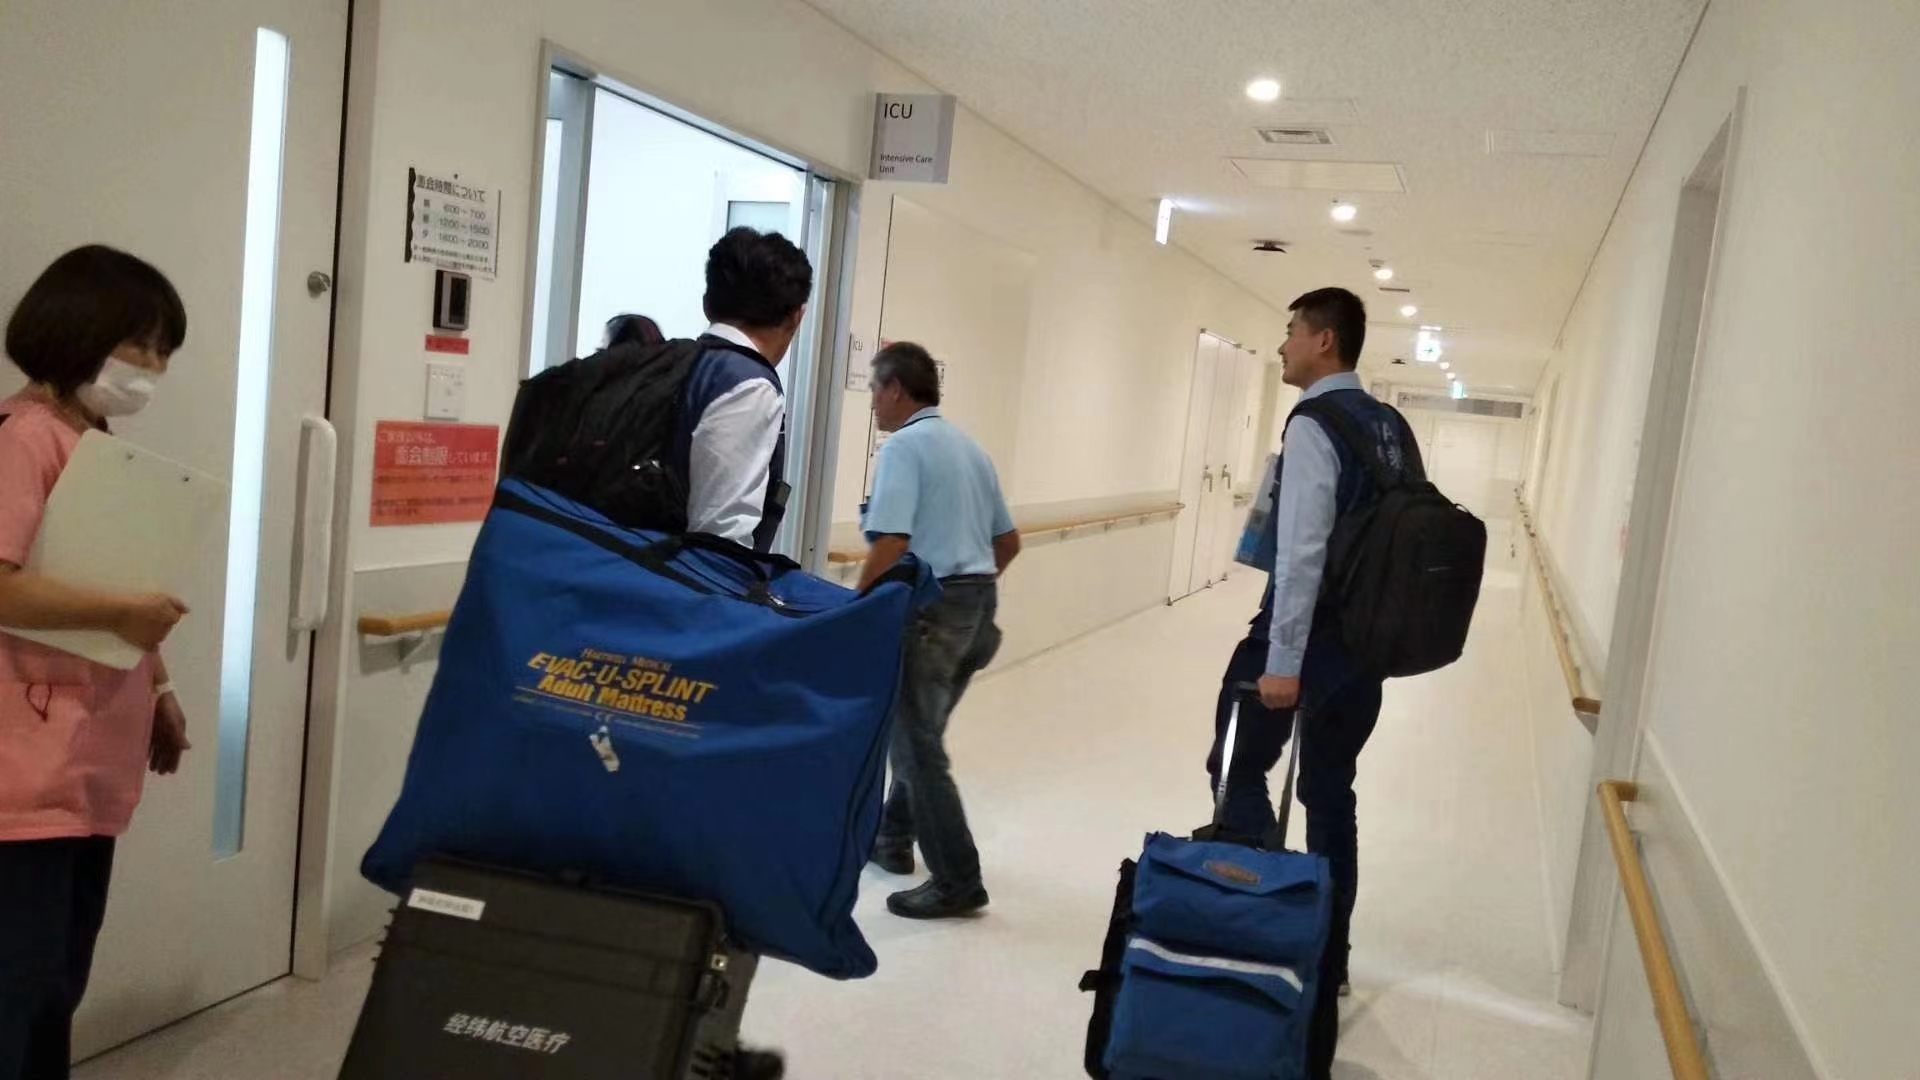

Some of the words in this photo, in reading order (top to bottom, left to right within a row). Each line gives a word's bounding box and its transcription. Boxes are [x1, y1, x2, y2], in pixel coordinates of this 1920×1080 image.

[883, 102, 913, 119] ICU
[879, 165, 895, 174] Unit
[880, 153, 914, 163] Intensive
[915, 155, 933, 164] Care
[527, 651, 719, 704] EVAC-U-SPLINT
[537, 675, 595, 703] Adult
[596, 686, 688, 721] Mattress
[442, 1012, 572, 1054] 经纬航空医疗
